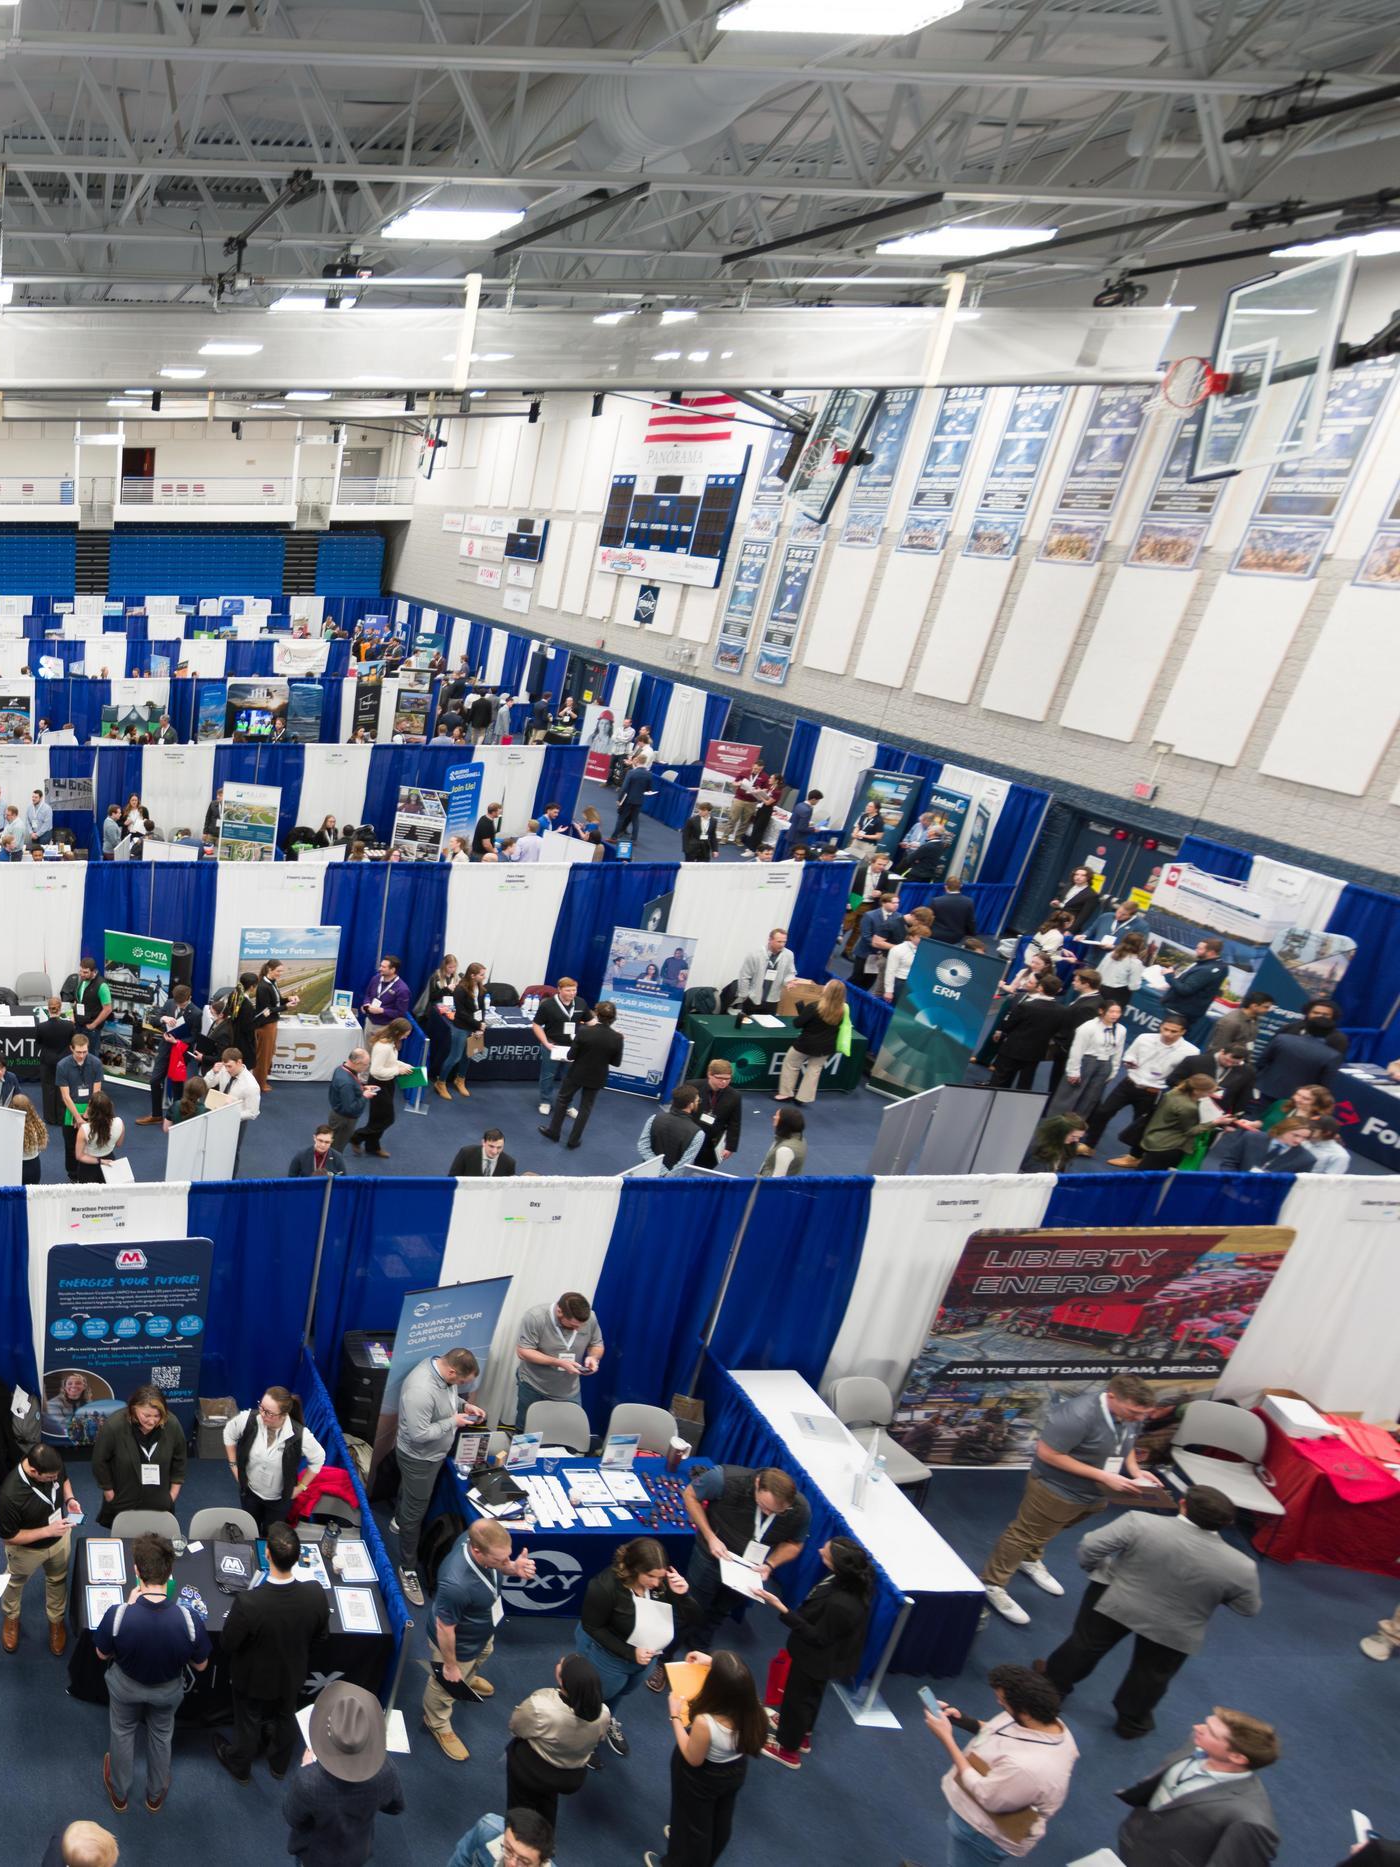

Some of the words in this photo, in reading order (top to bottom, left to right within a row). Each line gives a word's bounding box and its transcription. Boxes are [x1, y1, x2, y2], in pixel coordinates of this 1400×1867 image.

[885, 391, 914, 402] 2011
[646, 449, 704, 465] PANORAMA
[745, 545, 768, 555] 2021
[788, 549, 814, 560] 2022
[480, 568, 499, 580] ATOMIC
[452, 784, 464, 792] Join
[465, 782, 476, 790] Us!
[144, 950, 168, 962] CMTA
[932, 985, 962, 1000] ERM
[609, 996, 637, 1007] SOLAR
[638, 1000, 671, 1012] POWER
[122, 1252, 141, 1262] M
[983, 1248, 1169, 1269] LIBERTY
[59, 1277, 115, 1288] ENERGIZE
[120, 1275, 149, 1286] YOUR
[154, 1275, 200, 1285] FUTURE!
[971, 1275, 1153, 1294] ENERGY
[410, 1316, 456, 1330] ADVANCE
[457, 1312, 483, 1322] YOUR
[409, 1326, 445, 1338] CAREER
[447, 1322, 466, 1331] AND
[407, 1335, 428, 1345] OUR
[428, 1331, 462, 1341] WORLD
[947, 1367, 984, 1375] JOIN
[1060, 1366, 1109, 1374] DAMN
[1111, 1366, 1157, 1375] TEAM,
[1160, 1365, 1220, 1374] PERIOD.
[224, 1557, 245, 1574] M
